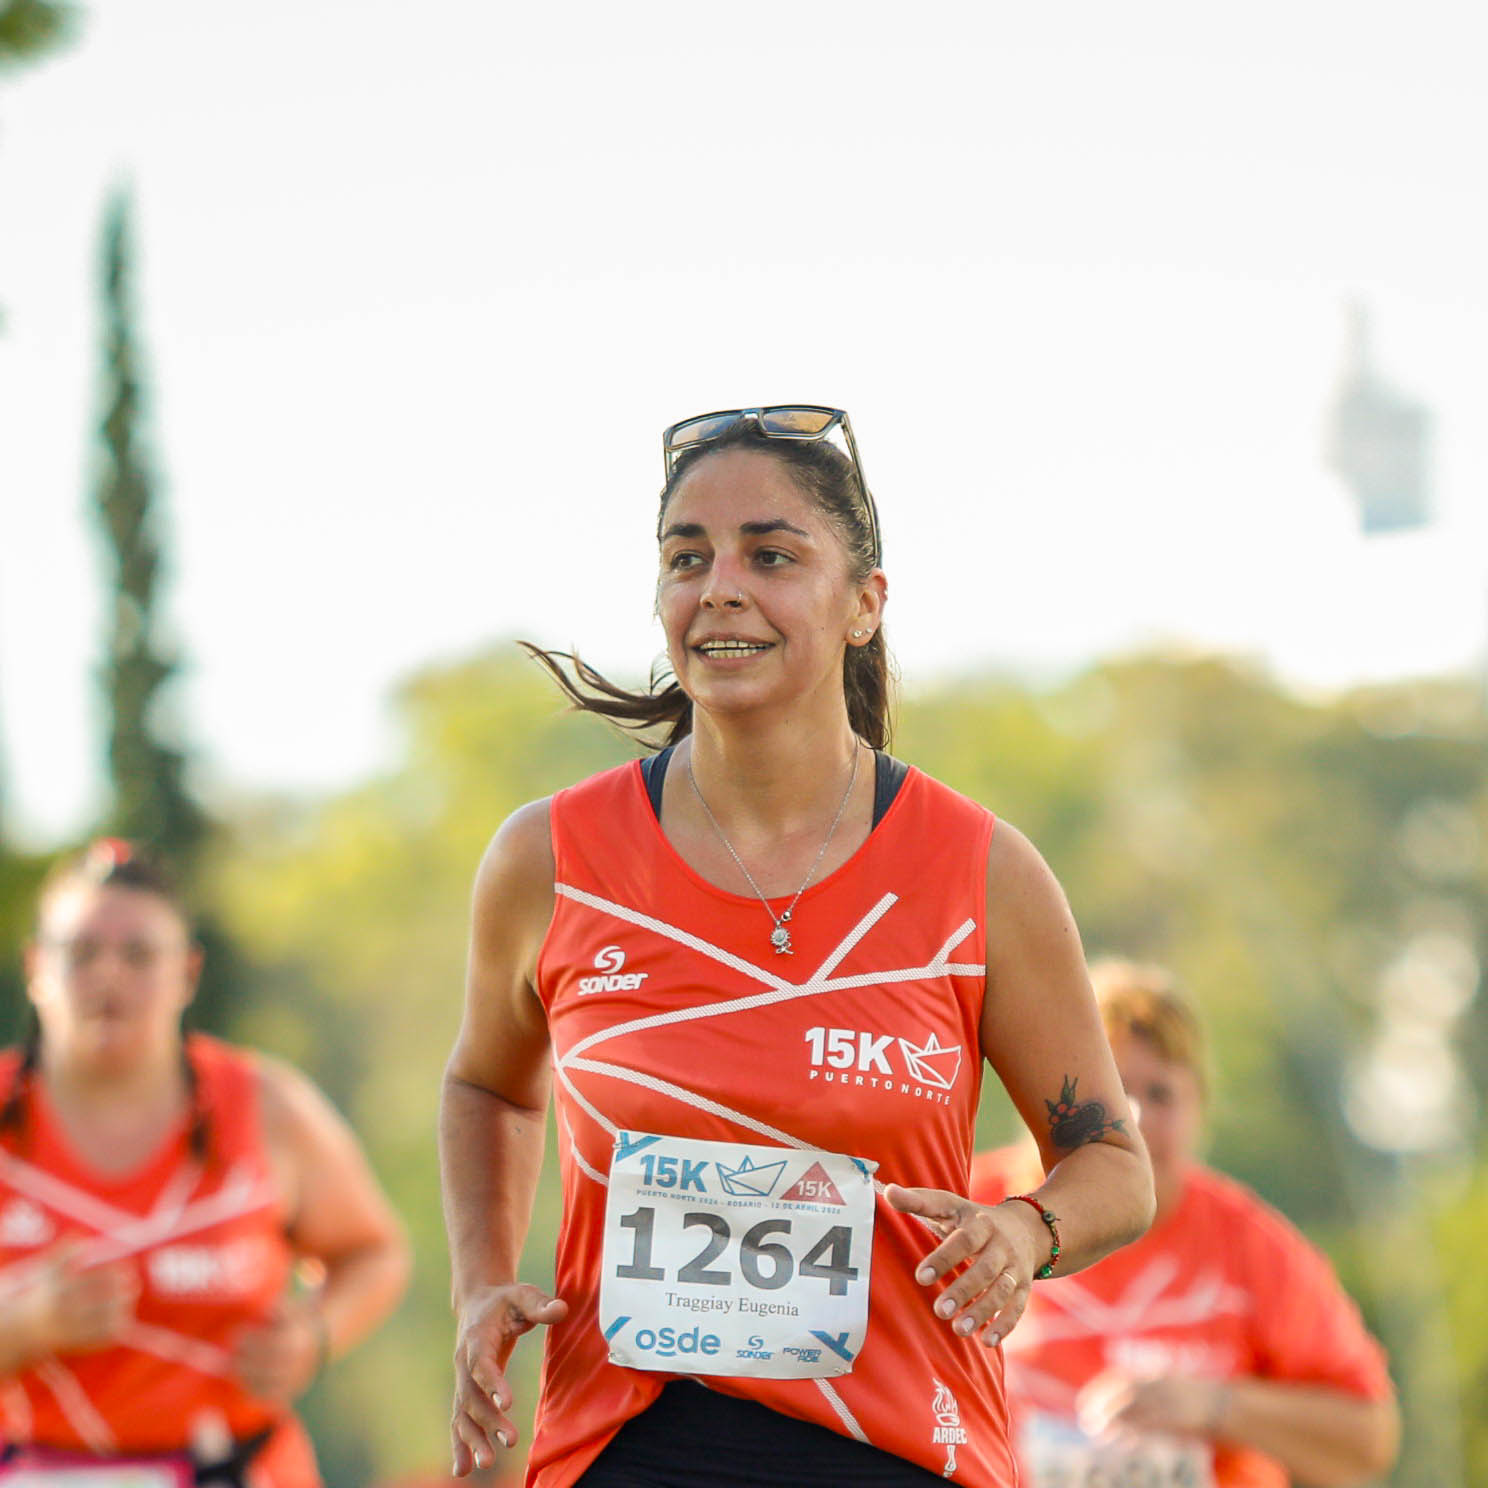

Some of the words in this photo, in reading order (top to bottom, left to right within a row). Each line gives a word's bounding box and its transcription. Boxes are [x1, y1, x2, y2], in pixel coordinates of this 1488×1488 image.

[805, 1027, 895, 1075] 15K
[810, 1070, 893, 1090] PUERTO
[901, 1083, 951, 1105] NORTE
[640, 1154, 709, 1192] 15K
[637, 1189, 668, 1198] PUERTO
[670, 1193, 696, 1202] NORTE
[727, 1200, 762, 1208] ROSARIO
[797, 1181, 832, 1198] 15K
[616, 1206, 858, 1296] 1264
[665, 1292, 733, 1314] Traggiay
[738, 1297, 799, 1317] Eugenia
[636, 1326, 721, 1356] osde
